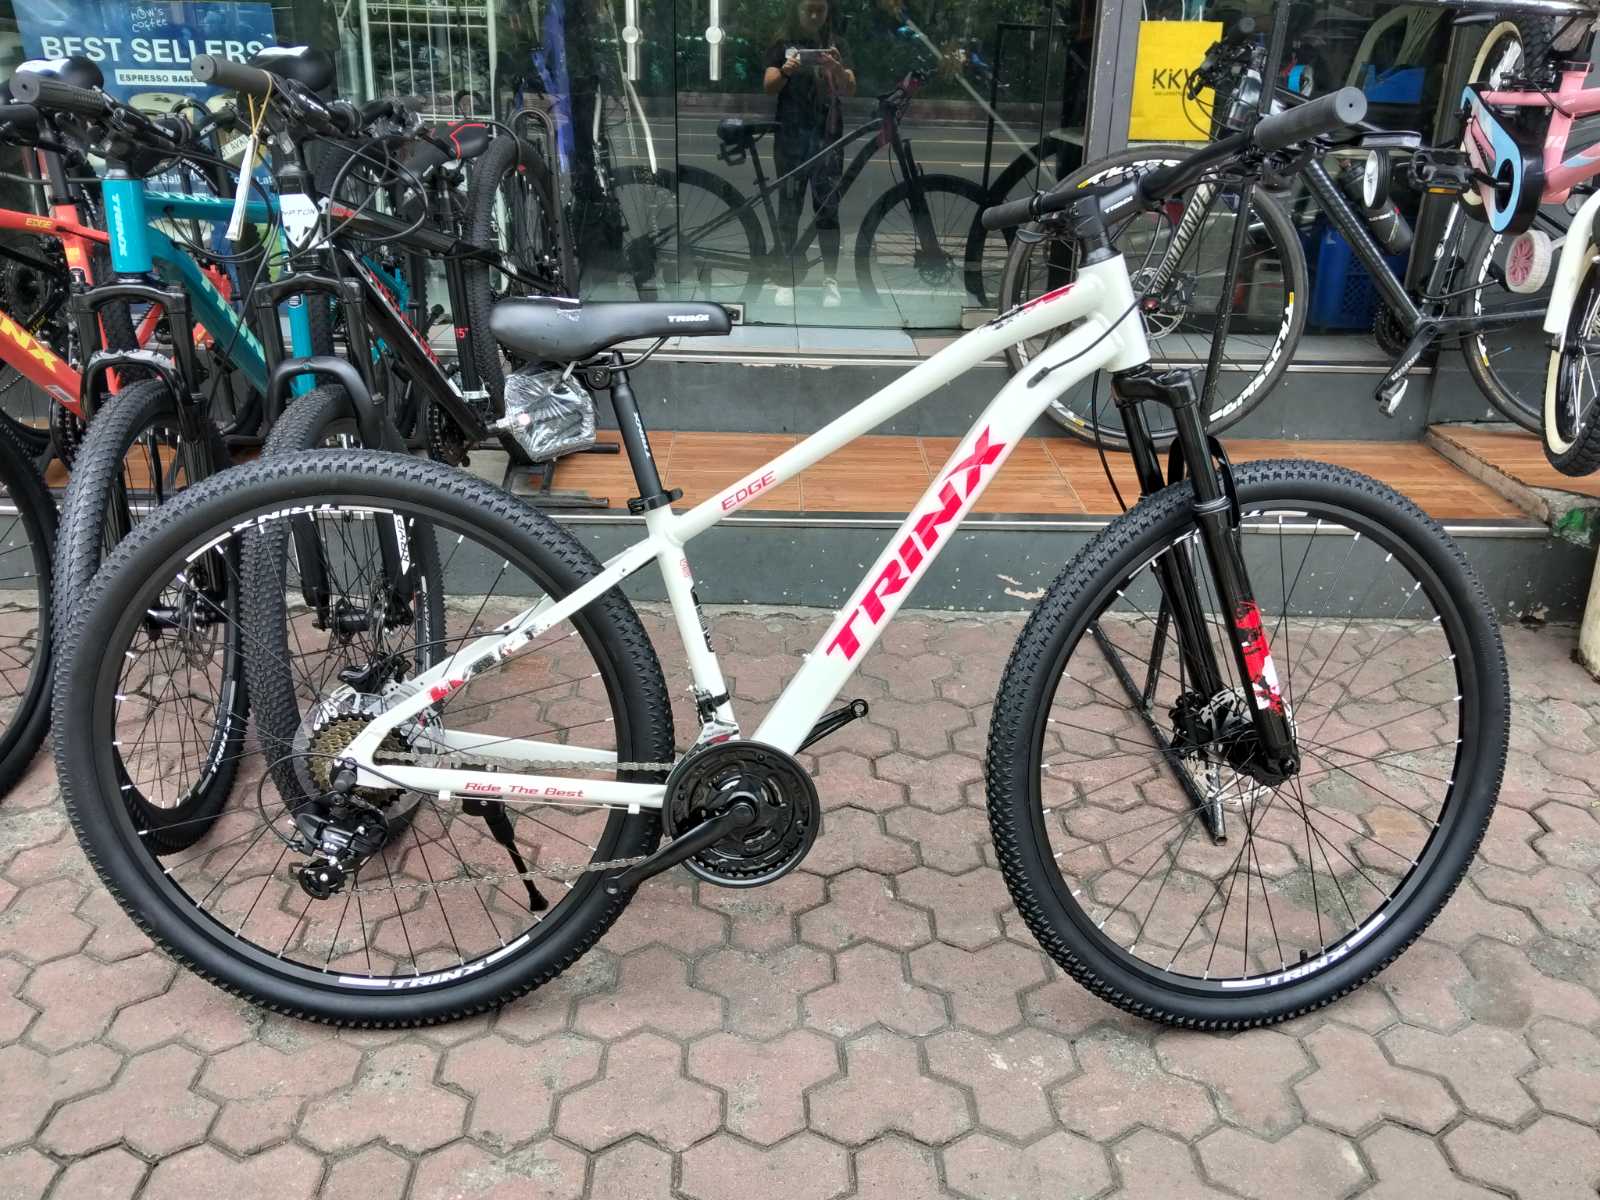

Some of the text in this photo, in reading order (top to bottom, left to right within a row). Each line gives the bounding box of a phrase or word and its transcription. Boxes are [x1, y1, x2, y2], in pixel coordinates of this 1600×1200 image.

[40, 36, 121, 61] BEST
[119, 73, 169, 83] ESPRESSO
[668, 314, 710, 323] TRINX
[721, 470, 777, 511] EDGE
[826, 424, 1007, 661] TRINX
[464, 782, 584, 798] Ride The Best
[391, 961, 486, 989] TRINX
[1267, 945, 1349, 986] TRINX
